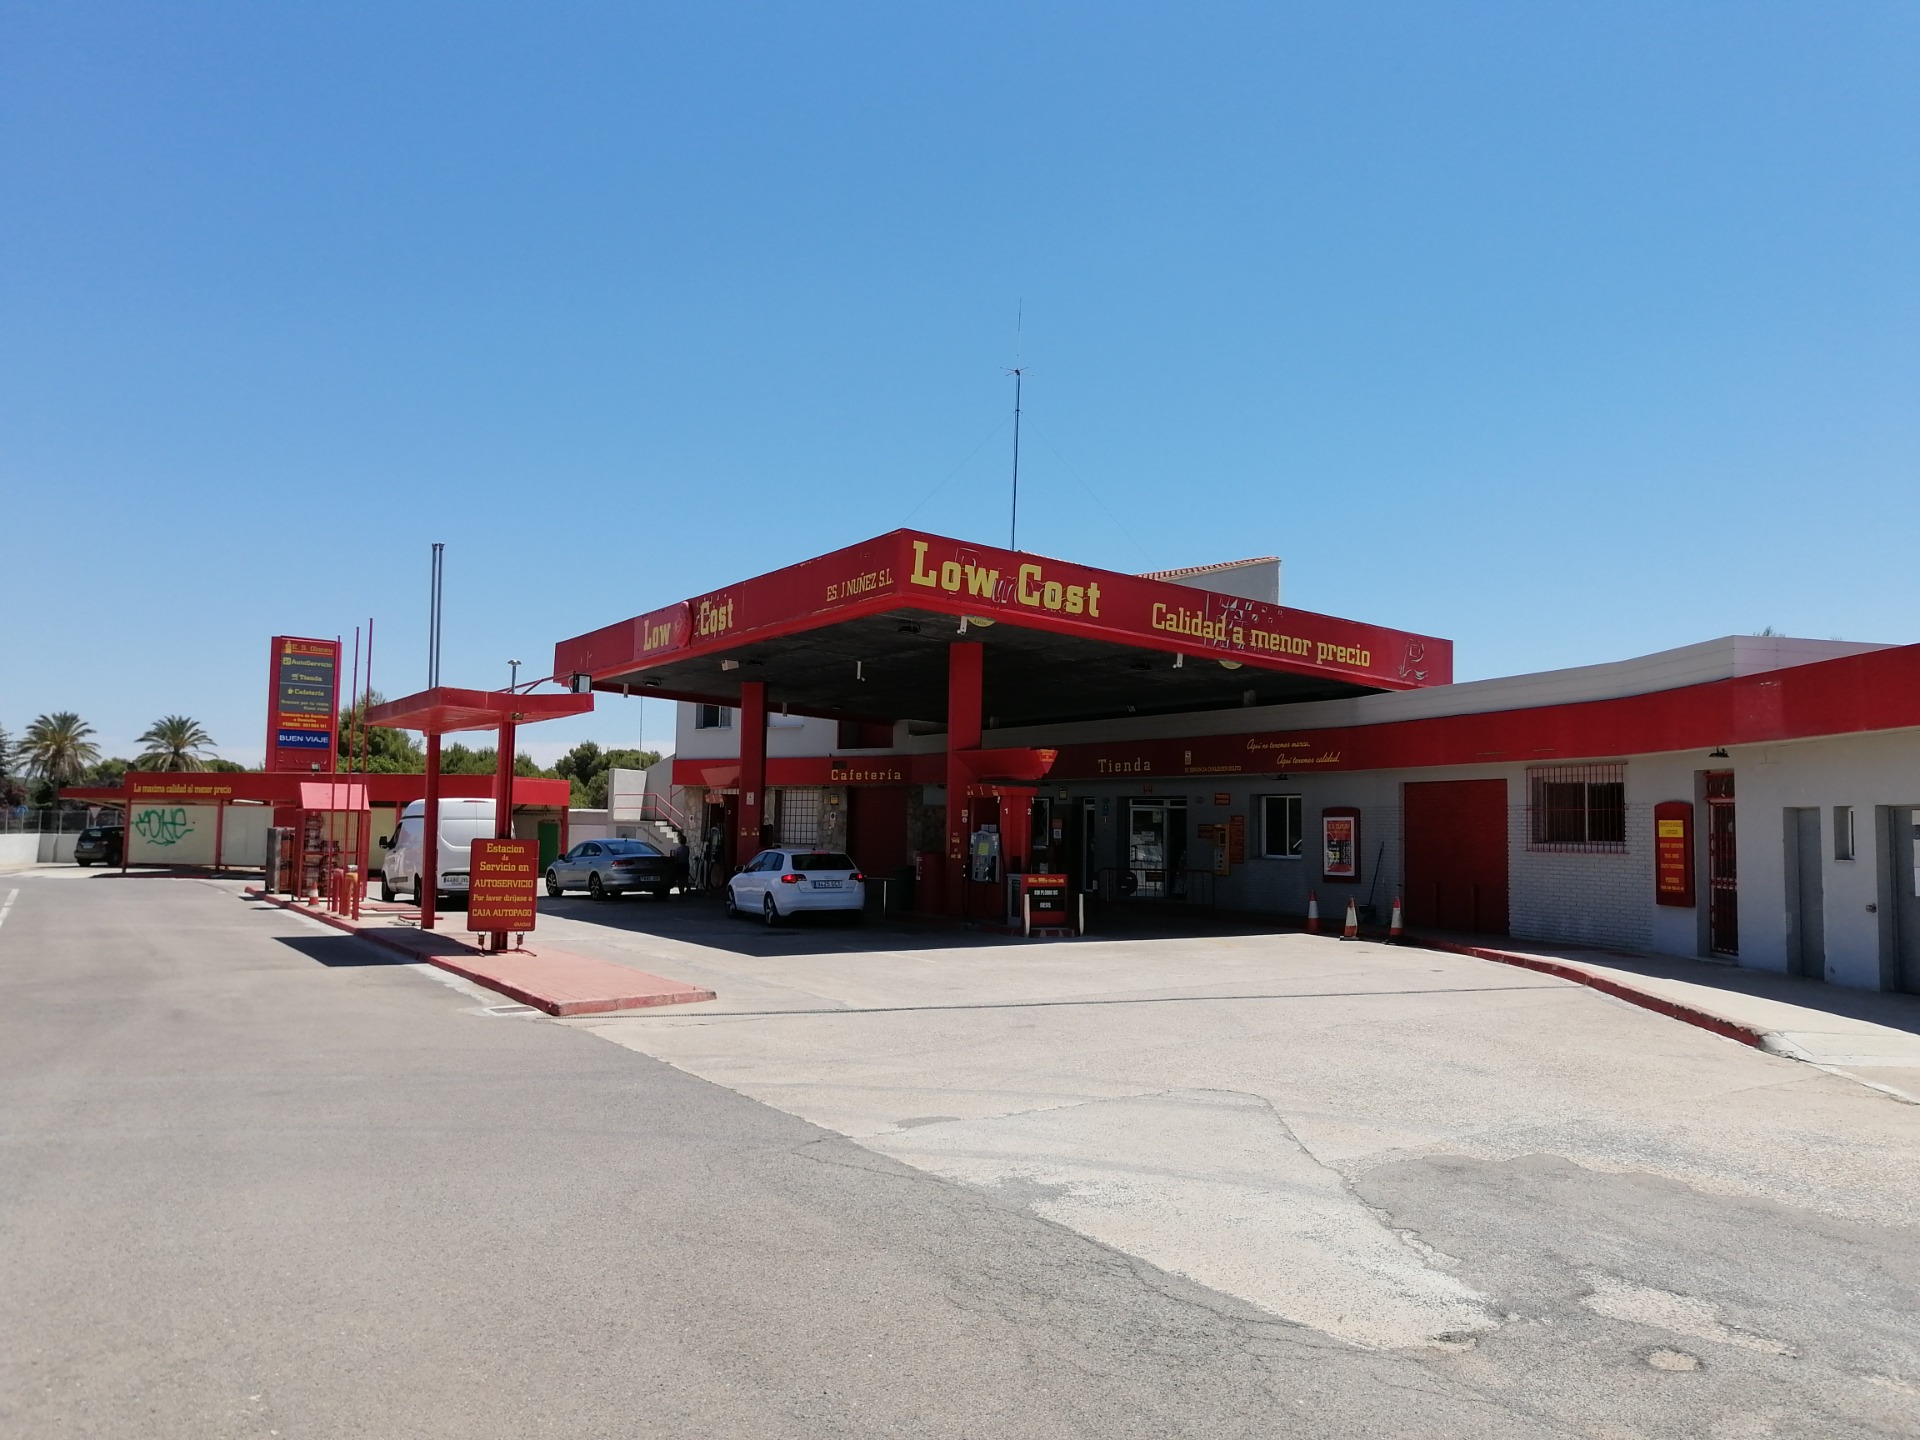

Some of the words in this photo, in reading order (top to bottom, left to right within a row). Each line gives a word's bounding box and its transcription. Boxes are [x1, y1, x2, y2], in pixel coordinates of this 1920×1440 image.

[847, 572, 877, 596] NUÑEZ
[879, 568, 894, 588] S.L.
[910, 540, 999, 598] Low
[1017, 563, 1101, 618] Cost
[643, 619, 671, 651] Low
[700, 597, 734, 636] Cost
[1152, 602, 1227, 641] Calidad
[1233, 625, 1244, 646] a
[1250, 628, 1312, 656] menor
[1316, 643, 1371, 668] precio
[279, 734, 304, 742] BUEN
[305, 736, 329, 744] VIAJE
[1097, 757, 1151, 773] Tienda
[831, 768, 902, 781] Cafetería
[133, 782, 141, 793] La
[166, 783, 187, 794] calidad
[187, 784, 193, 794] al
[194, 786, 213, 794] menor
[213, 785, 232, 796] precio
[1004, 807, 1009, 815] 1
[1027, 807, 1032, 815] 2
[486, 843, 525, 853] Estacion
[479, 861, 516, 871] Servicio
[518, 864, 530, 872] en
[474, 879, 534, 888] AUTOSERVICIO
[472, 893, 485, 901] Por
[472, 908, 491, 917] CAJA
[492, 908, 532, 917] AUTOPAGO
